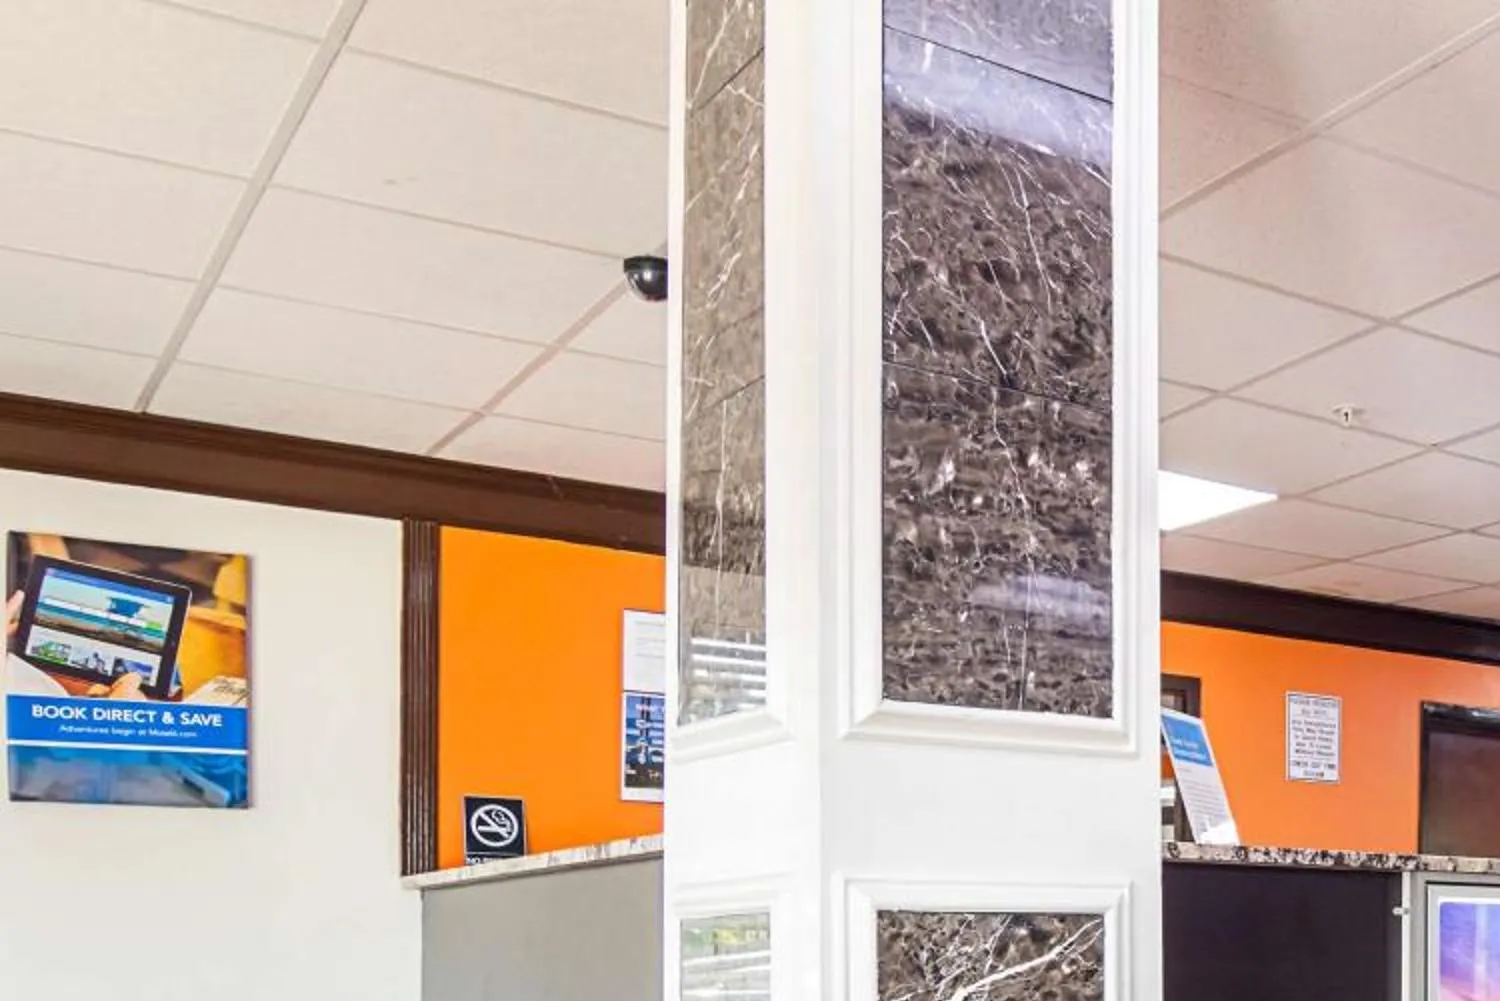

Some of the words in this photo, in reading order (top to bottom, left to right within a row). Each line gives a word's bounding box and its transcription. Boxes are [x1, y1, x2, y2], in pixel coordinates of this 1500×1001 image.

[31, 704, 88, 720] BOOK
[92, 706, 157, 723] DIRECT
[162, 711, 175, 725] &
[180, 712, 224, 727] SAVE
